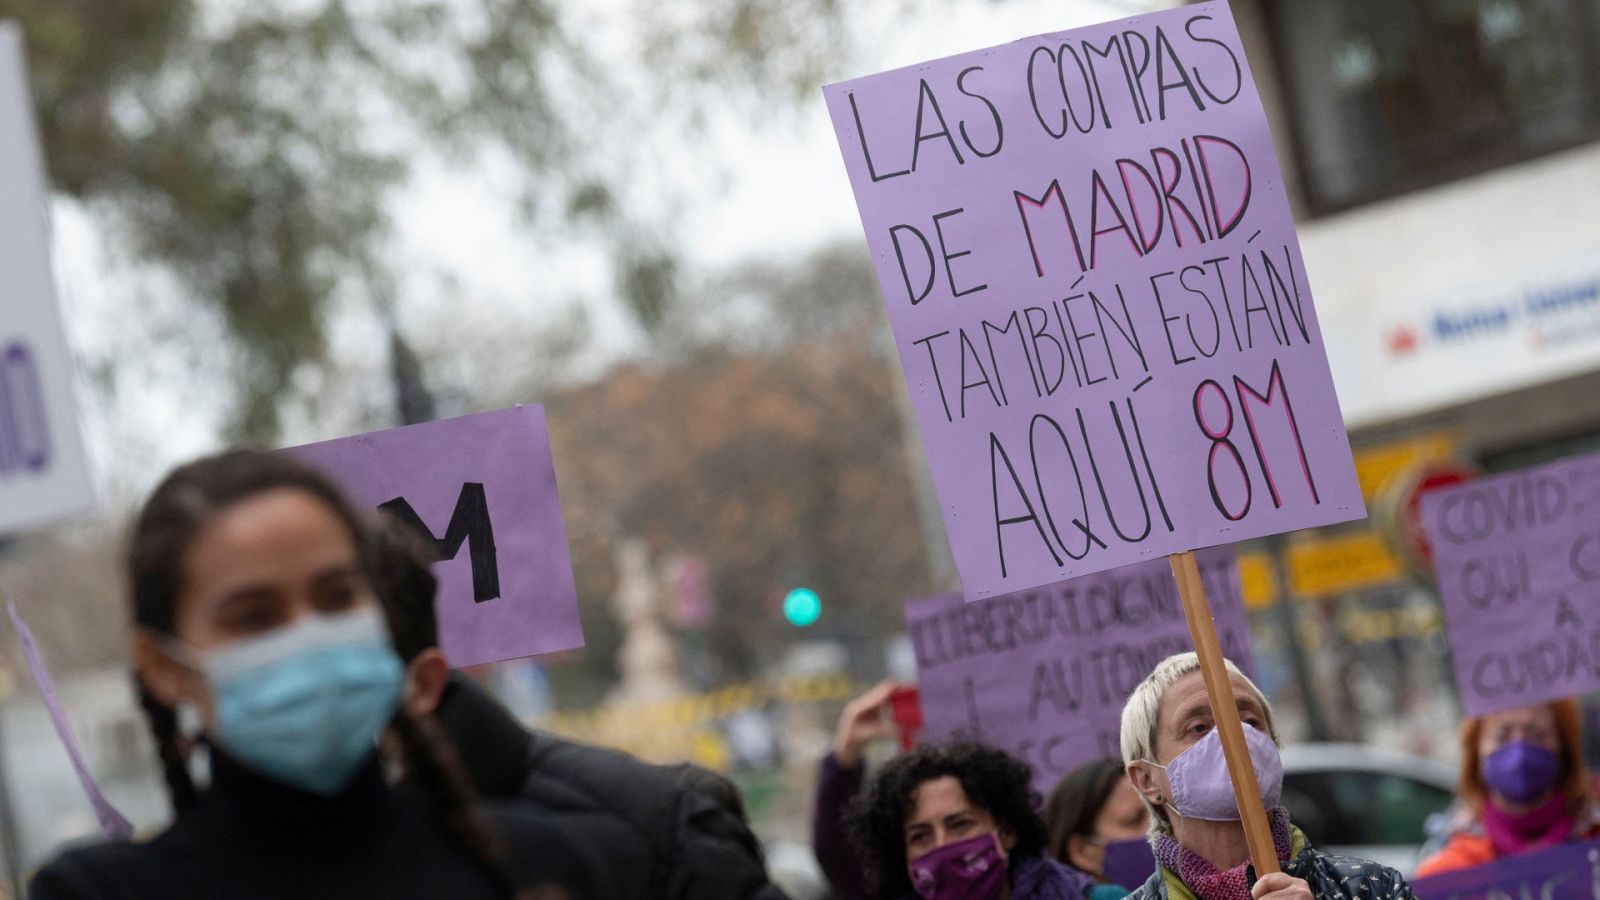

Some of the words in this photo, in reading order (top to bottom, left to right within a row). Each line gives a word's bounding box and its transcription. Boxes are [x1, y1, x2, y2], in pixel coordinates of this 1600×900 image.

[848, 66, 1003, 183] LAS
[1026, 15, 1242, 139] COMPAS
[888, 207, 988, 306] DE
[1013, 134, 1252, 278] MADRID
[912, 274, 1149, 423] TAMBIÉN
[1150, 229, 1310, 366] ESTÁN
[990, 376, 1175, 579] AQUÍ
[1193, 358, 1321, 522] 8M
[1459, 551, 1532, 610] QUI
